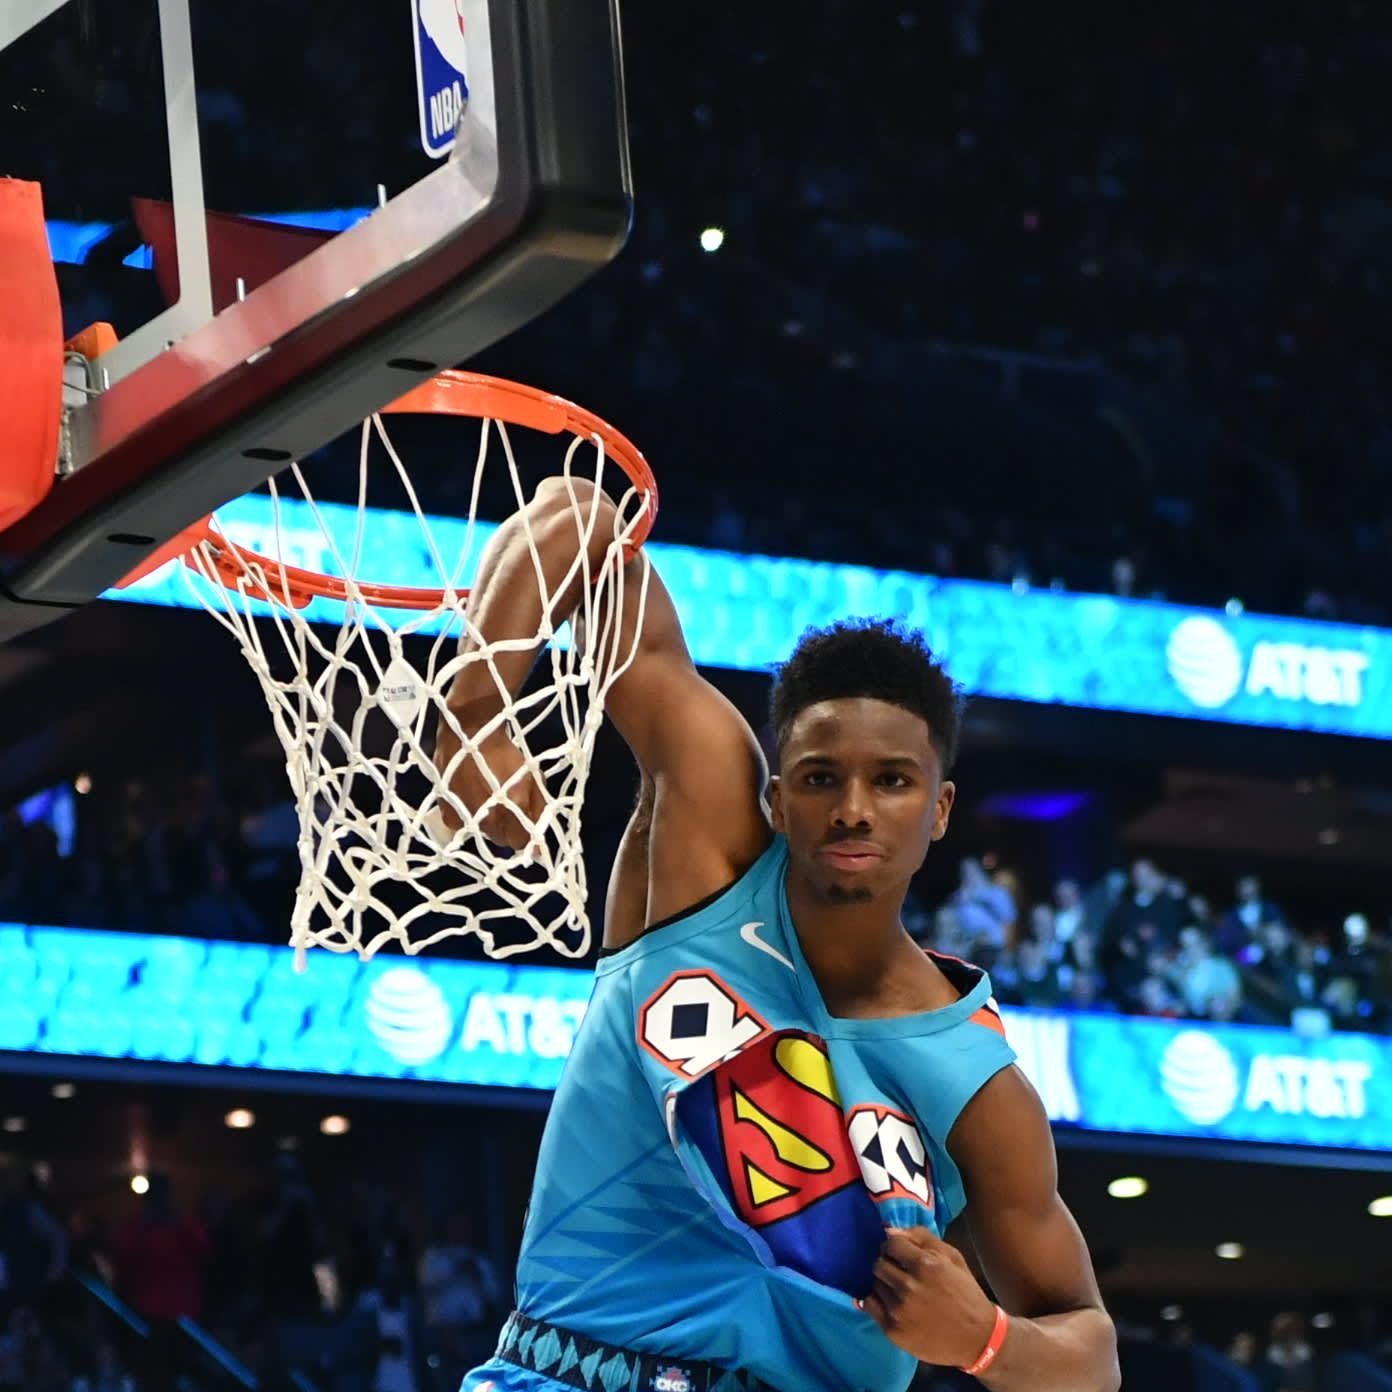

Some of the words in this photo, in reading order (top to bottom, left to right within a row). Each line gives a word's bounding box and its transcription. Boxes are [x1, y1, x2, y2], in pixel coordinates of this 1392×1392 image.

[430, 80, 464, 140] NBA
[1245, 640, 1370, 708] AT&T
[1245, 1054, 1371, 1120] AT&T
[655, 1379, 689, 1392] OKC
